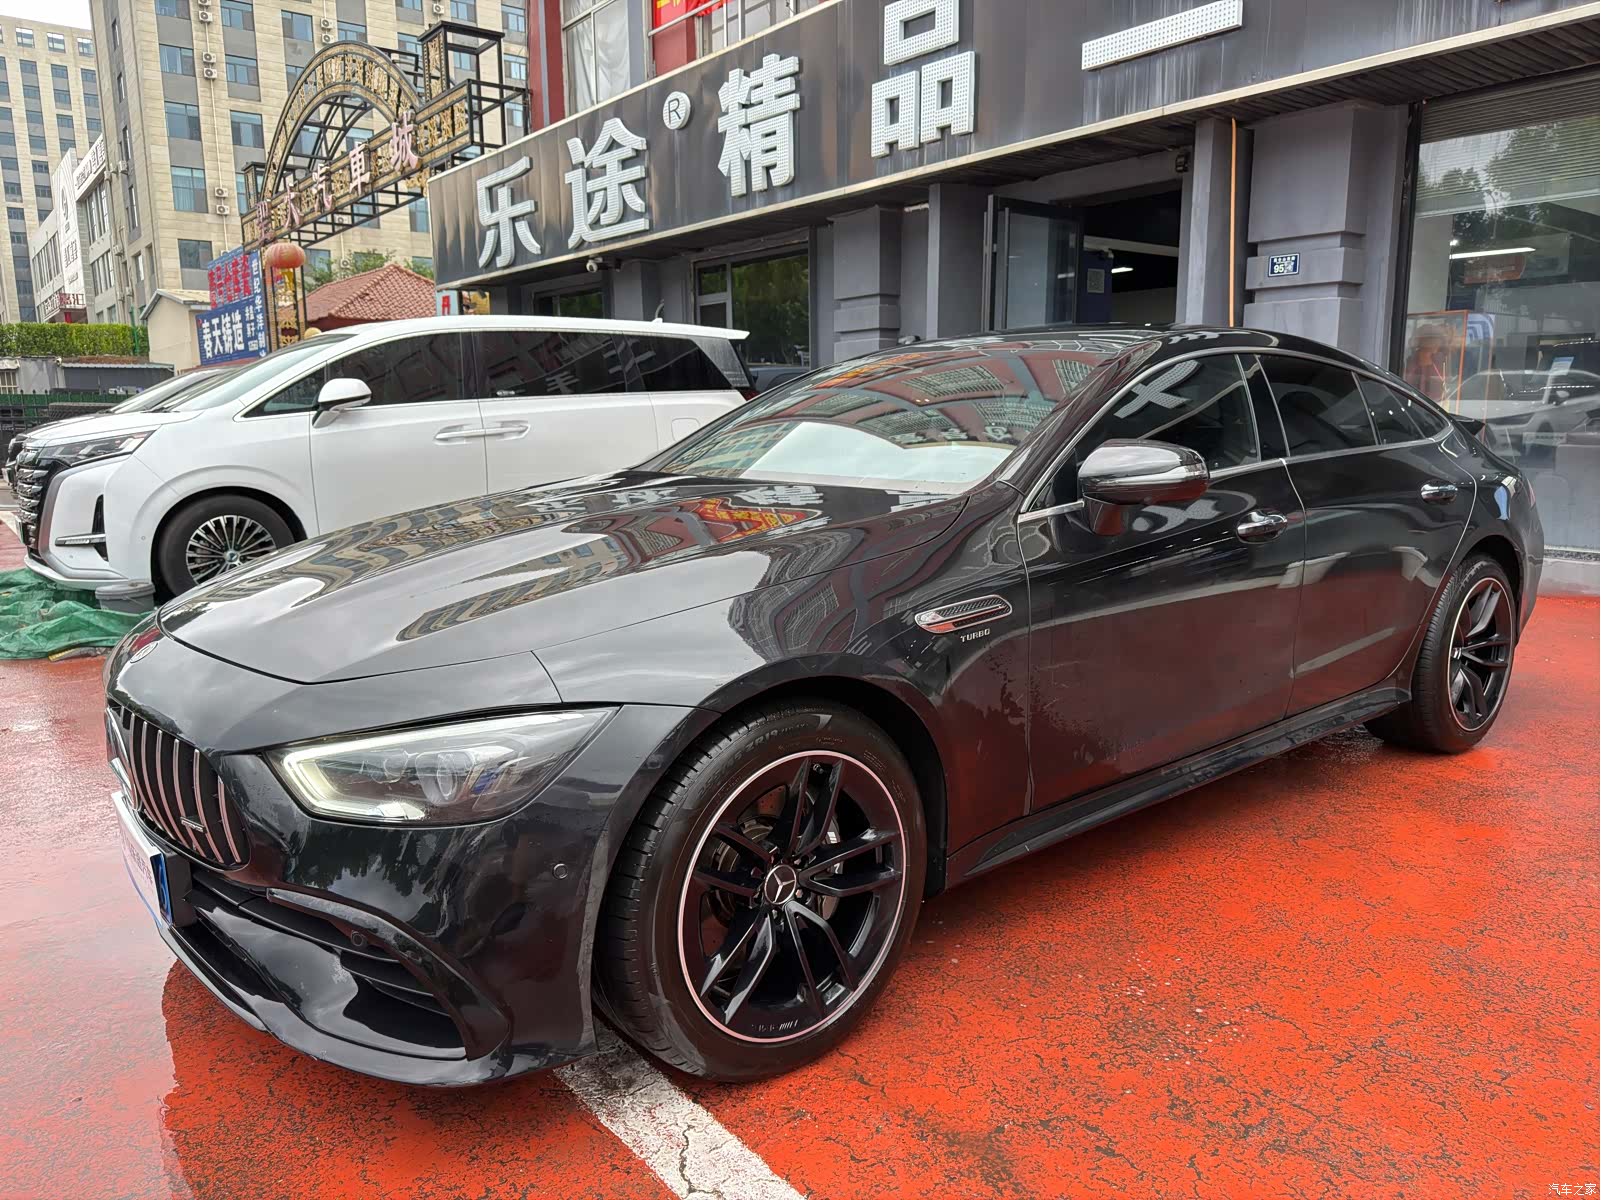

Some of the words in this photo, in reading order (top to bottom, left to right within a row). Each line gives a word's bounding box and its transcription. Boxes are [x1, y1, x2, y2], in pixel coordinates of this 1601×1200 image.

[202, 311, 244, 358] 春天铸造
[960, 628, 991, 643] TURBO
